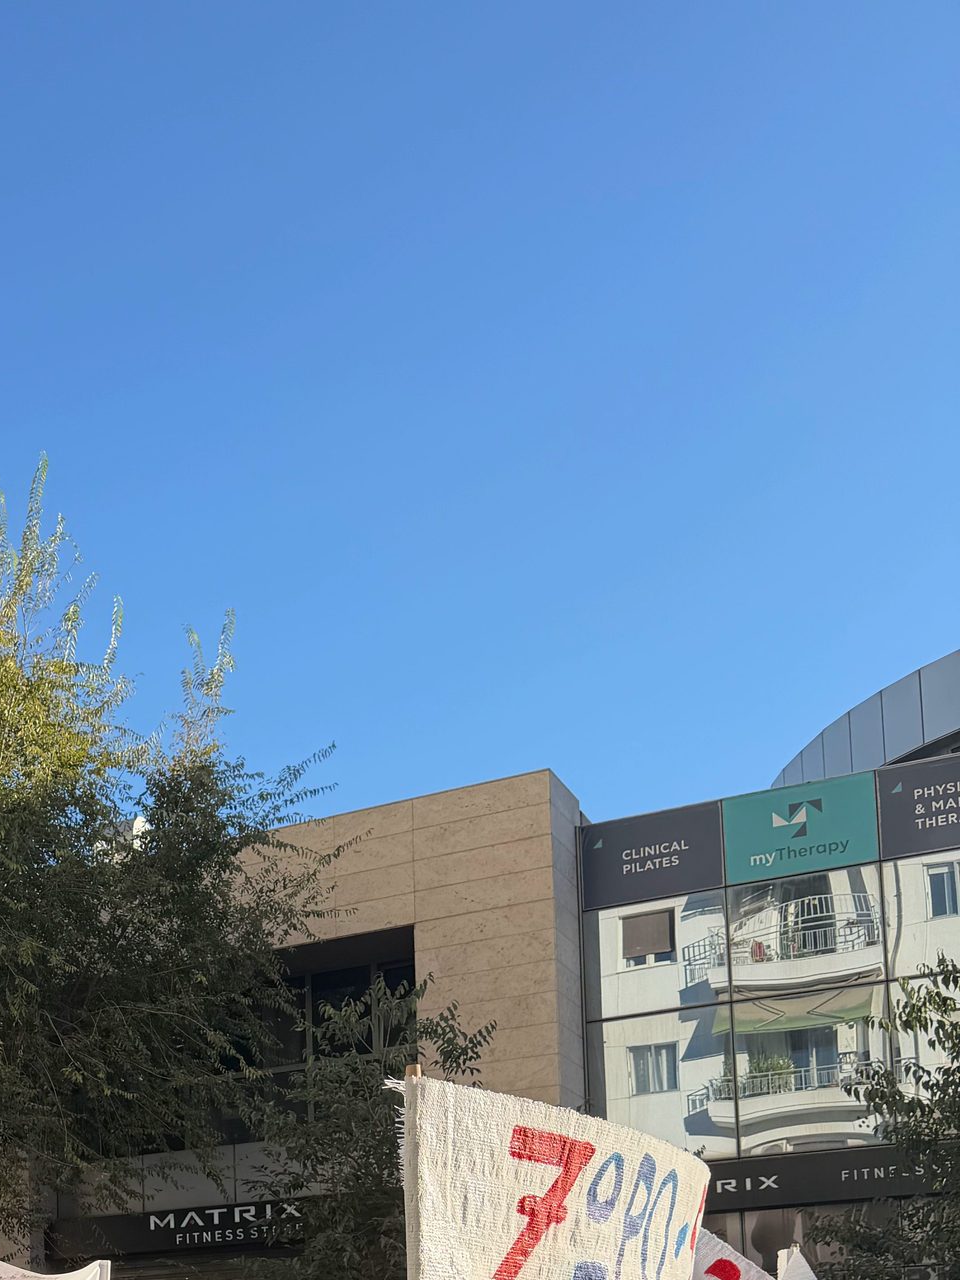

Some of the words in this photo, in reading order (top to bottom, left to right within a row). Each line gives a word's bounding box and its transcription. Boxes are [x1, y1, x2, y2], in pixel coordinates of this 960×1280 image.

[915, 814, 960, 829] THER
[622, 840, 689, 860] CLINICAL
[750, 840, 850, 867] myTherapy
[623, 855, 680, 875] PILATES
[150, 1202, 302, 1231] MATRIX
[176, 1229, 245, 1245] FITNESS
